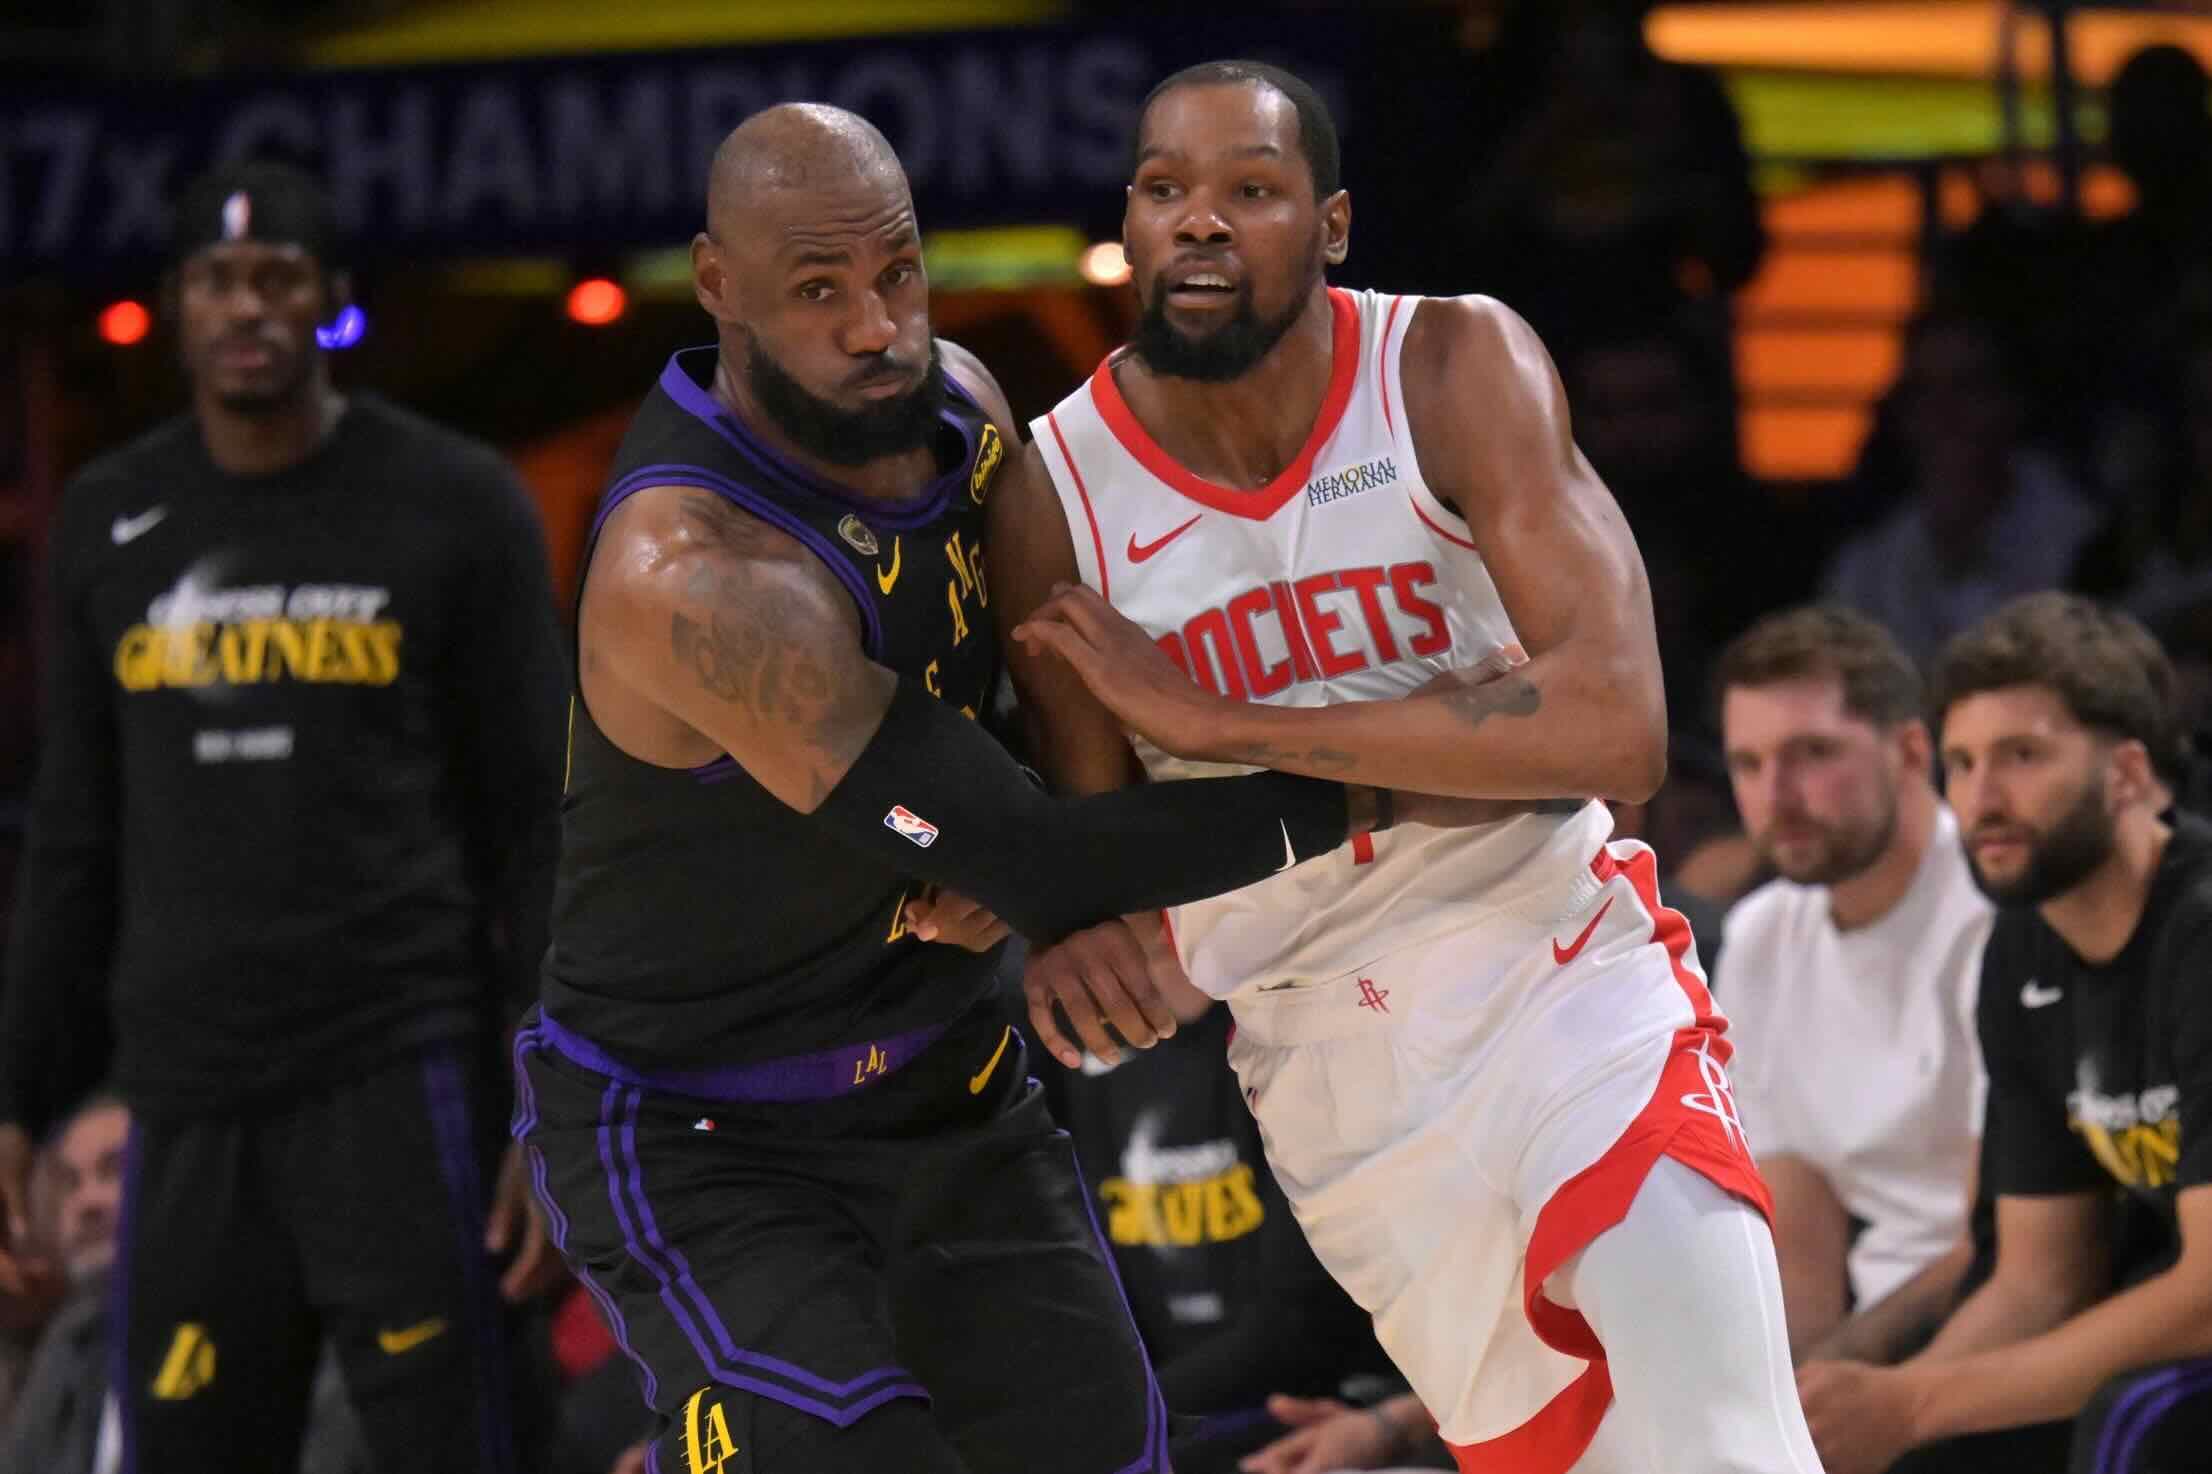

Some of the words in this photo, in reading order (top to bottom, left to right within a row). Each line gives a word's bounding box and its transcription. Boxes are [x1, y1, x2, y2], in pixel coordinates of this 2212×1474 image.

[1307, 456, 1397, 496] MEMORIAL
[1309, 466, 1398, 507] HERMANN
[853, 1044, 888, 1085] LAL
